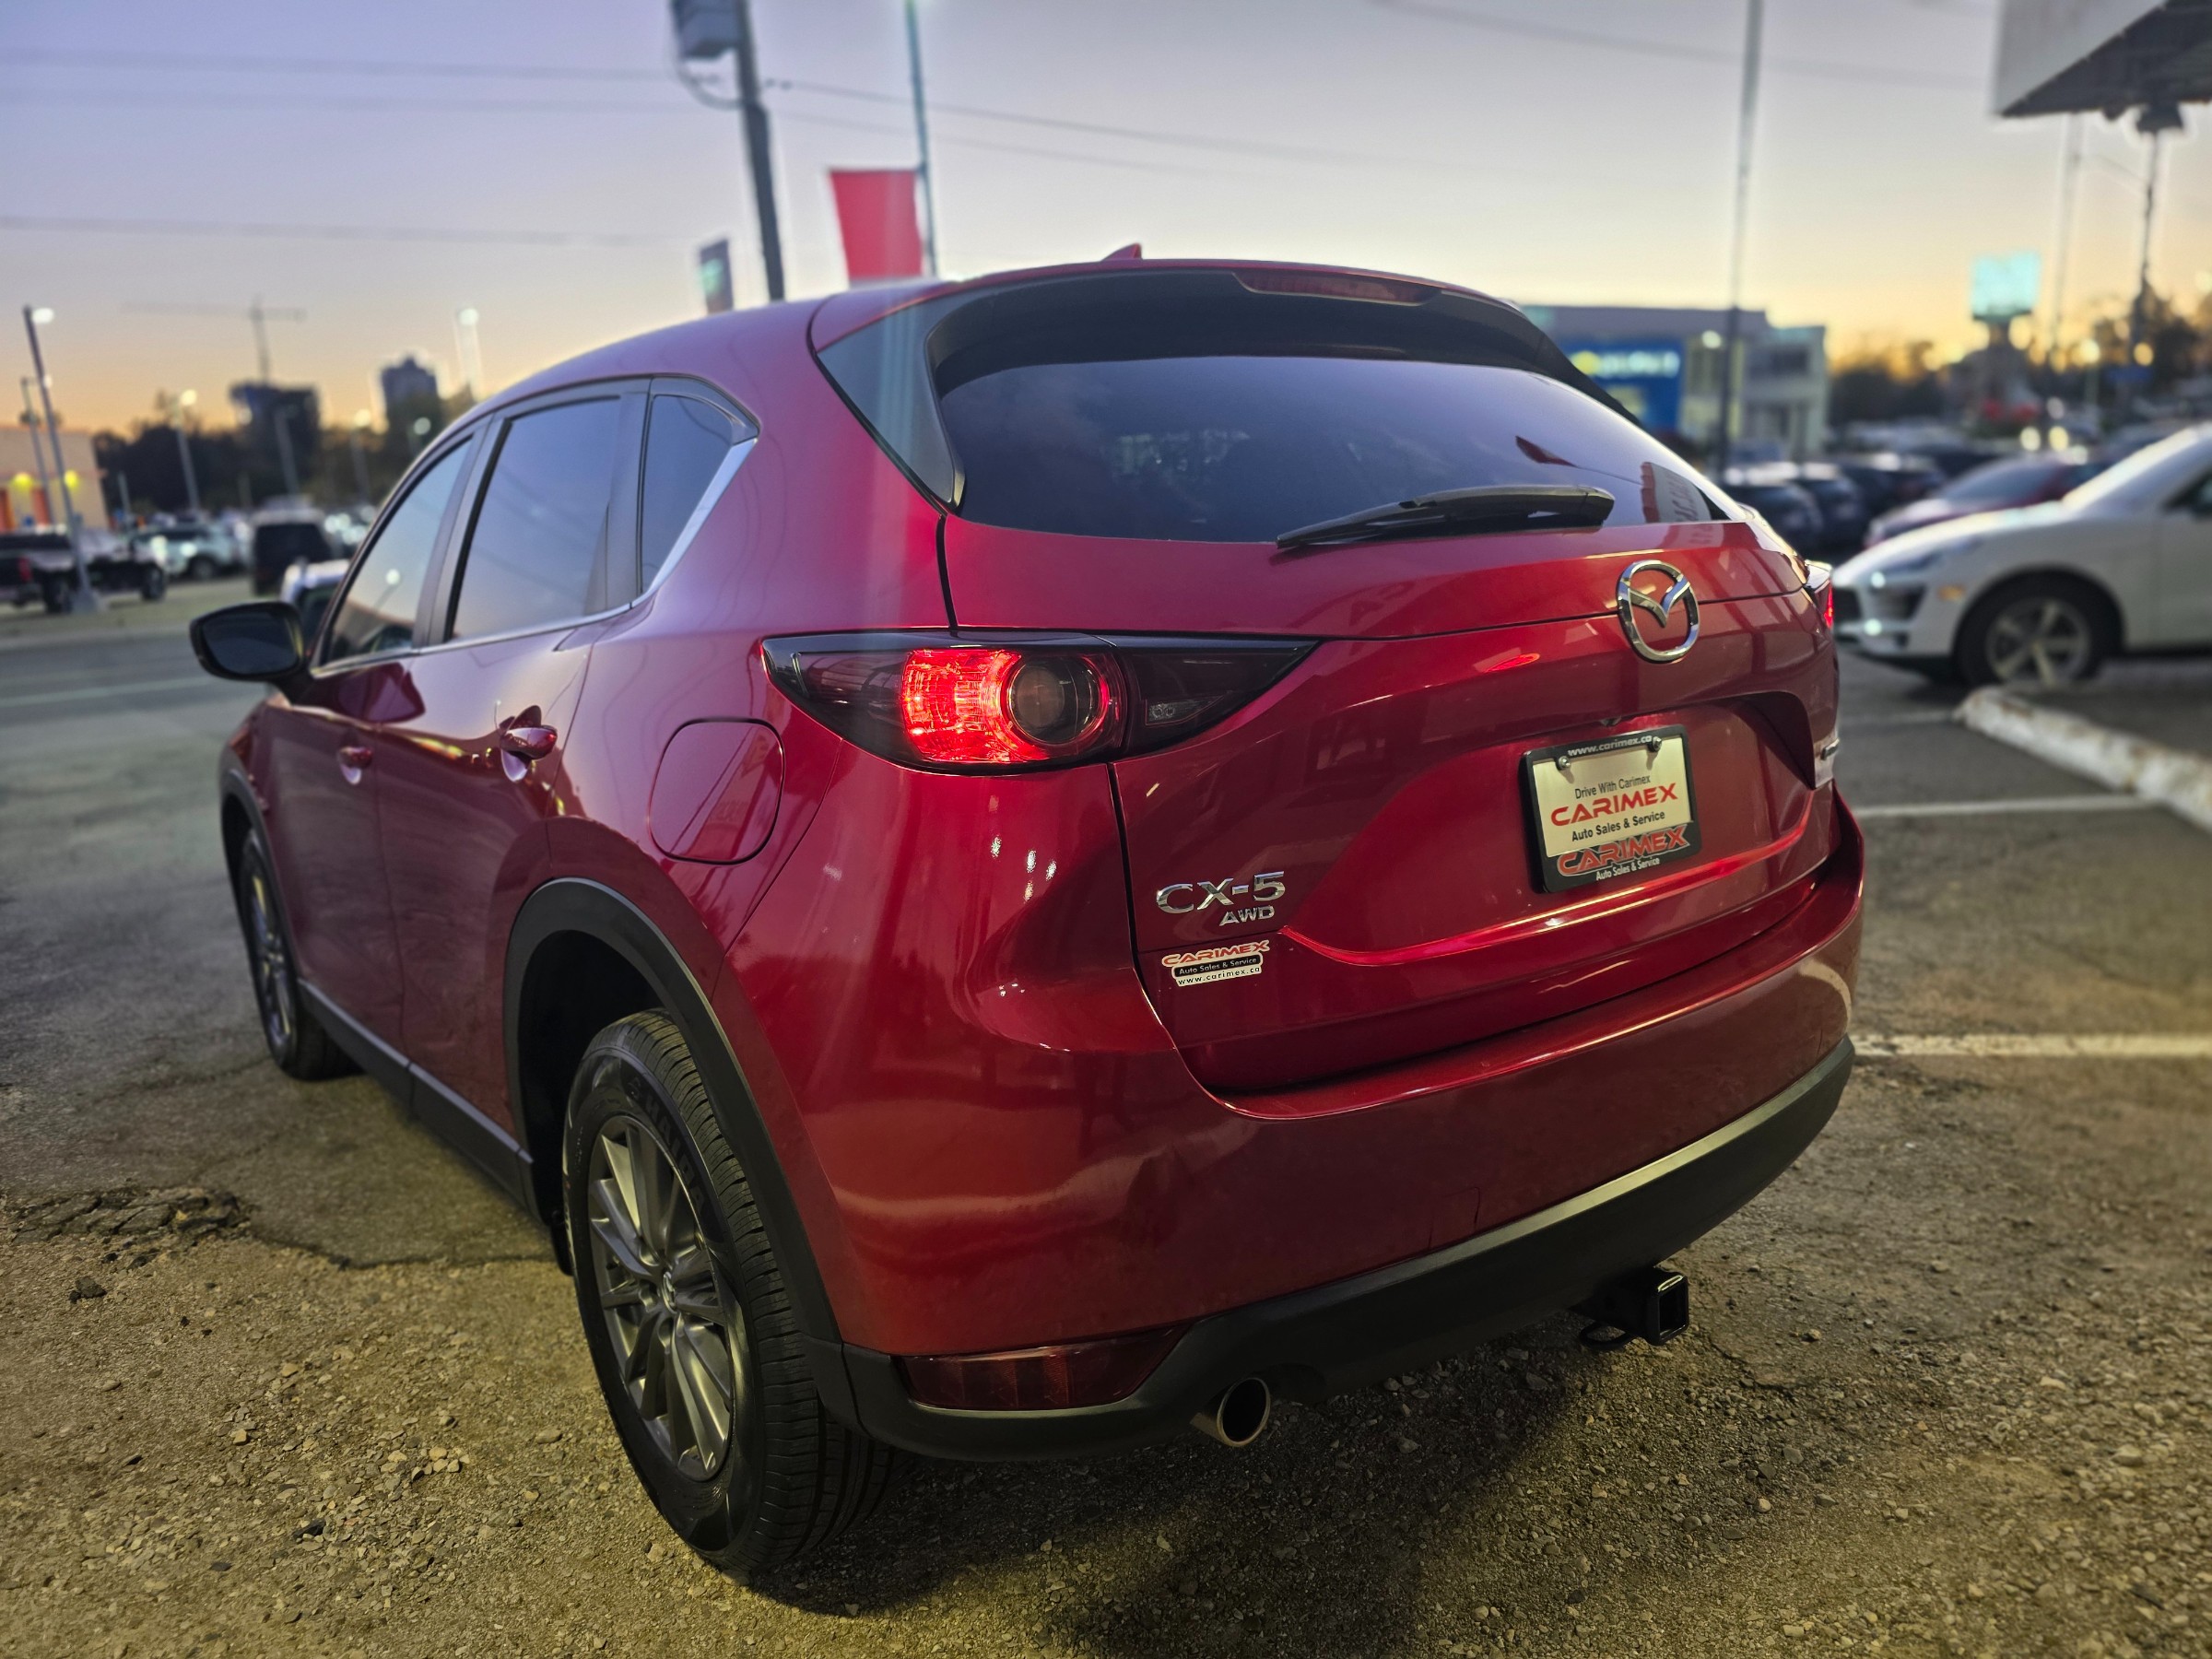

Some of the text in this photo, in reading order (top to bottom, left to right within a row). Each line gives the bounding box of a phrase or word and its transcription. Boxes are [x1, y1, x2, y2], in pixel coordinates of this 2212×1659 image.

[1575, 775, 1651, 799] Drive With Carimex
[1550, 782, 1678, 827] CARIMEX
[1571, 811, 1665, 841] Auto Sales & Service
[1558, 825, 1688, 876] CARIMEX
[1595, 856, 1661, 881] Auto Sales & Service
[1156, 870, 1286, 913] CX-5
[1218, 905, 1275, 926] AWD
[1162, 940, 1270, 965] CARIMEX
[1178, 967, 1261, 986] www.carimex.ca
[1179, 968, 1198, 976] Auto
[1199, 962, 1221, 973] Sales
[1230, 957, 1257, 968] Service
